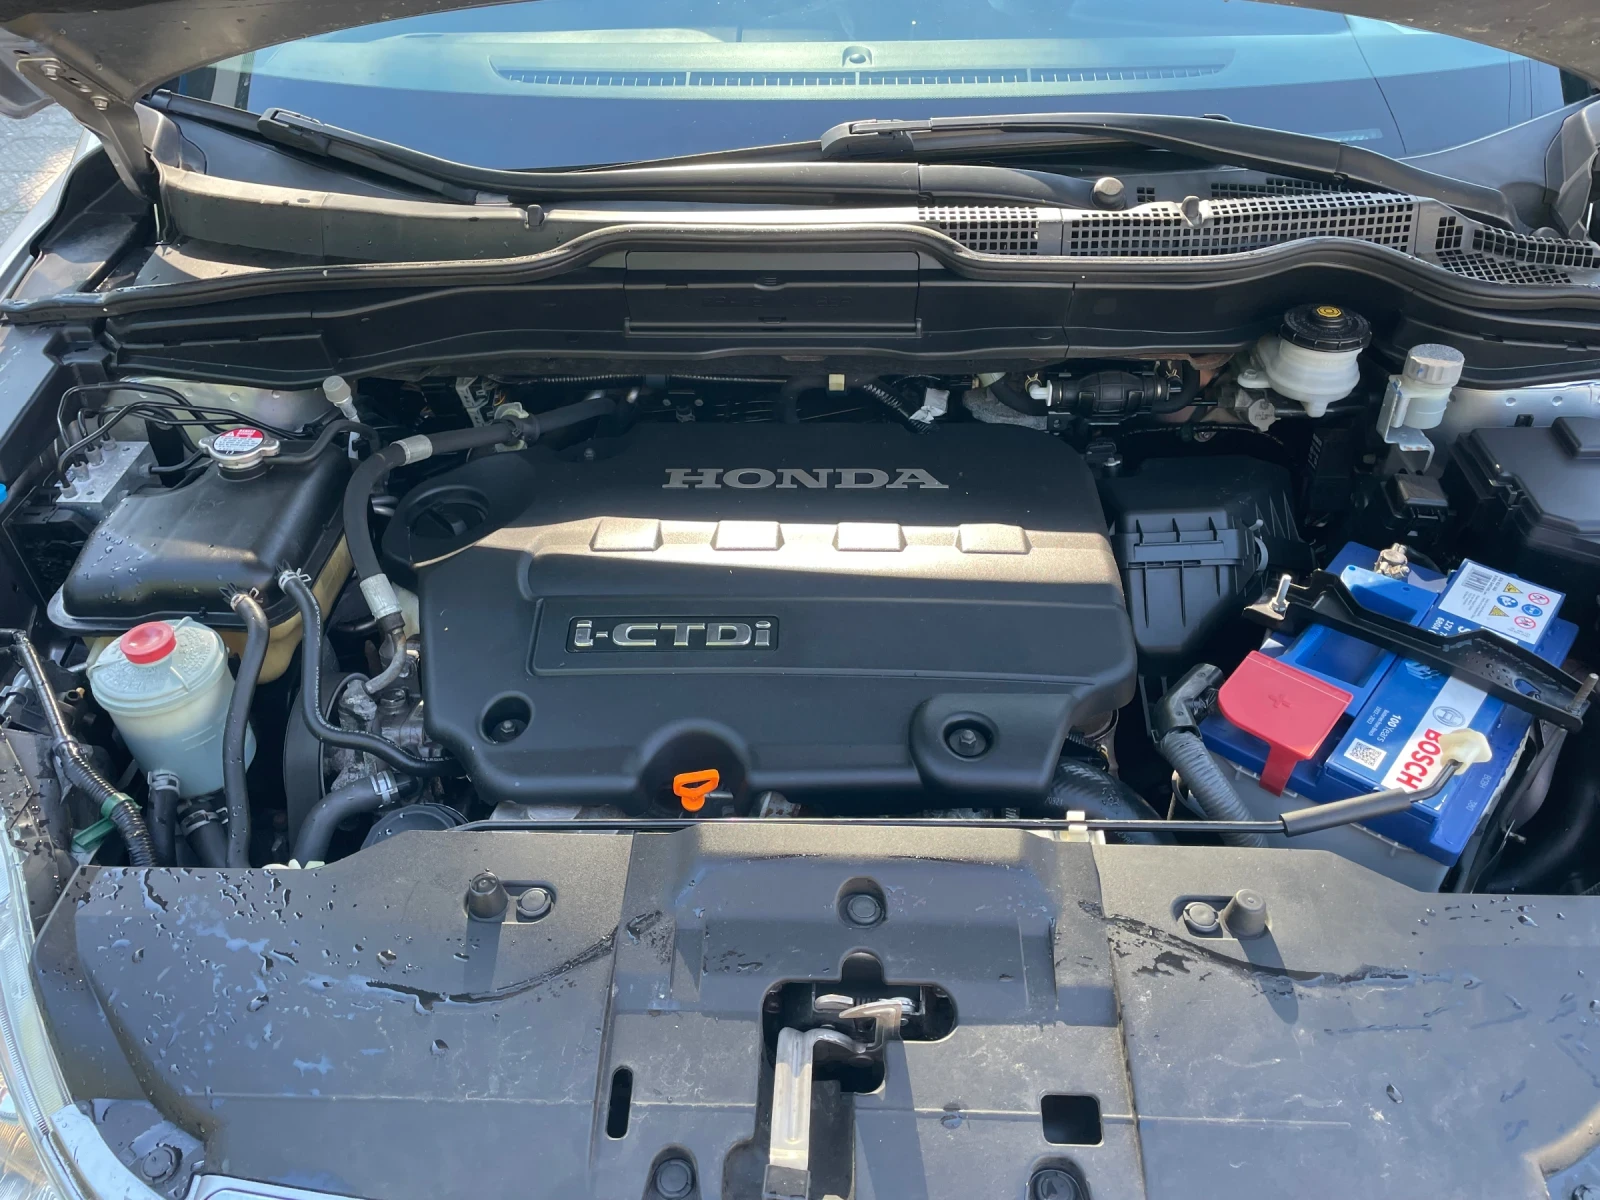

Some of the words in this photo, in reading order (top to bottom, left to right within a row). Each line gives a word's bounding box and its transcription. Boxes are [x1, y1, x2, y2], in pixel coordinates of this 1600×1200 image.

[662, 468, 949, 489] HONDA
[574, 620, 772, 647] i-CTDi
[1387, 714, 1402, 728] 100
[1376, 726, 1395, 743] Years
[1396, 728, 1442, 790] BOSCH
